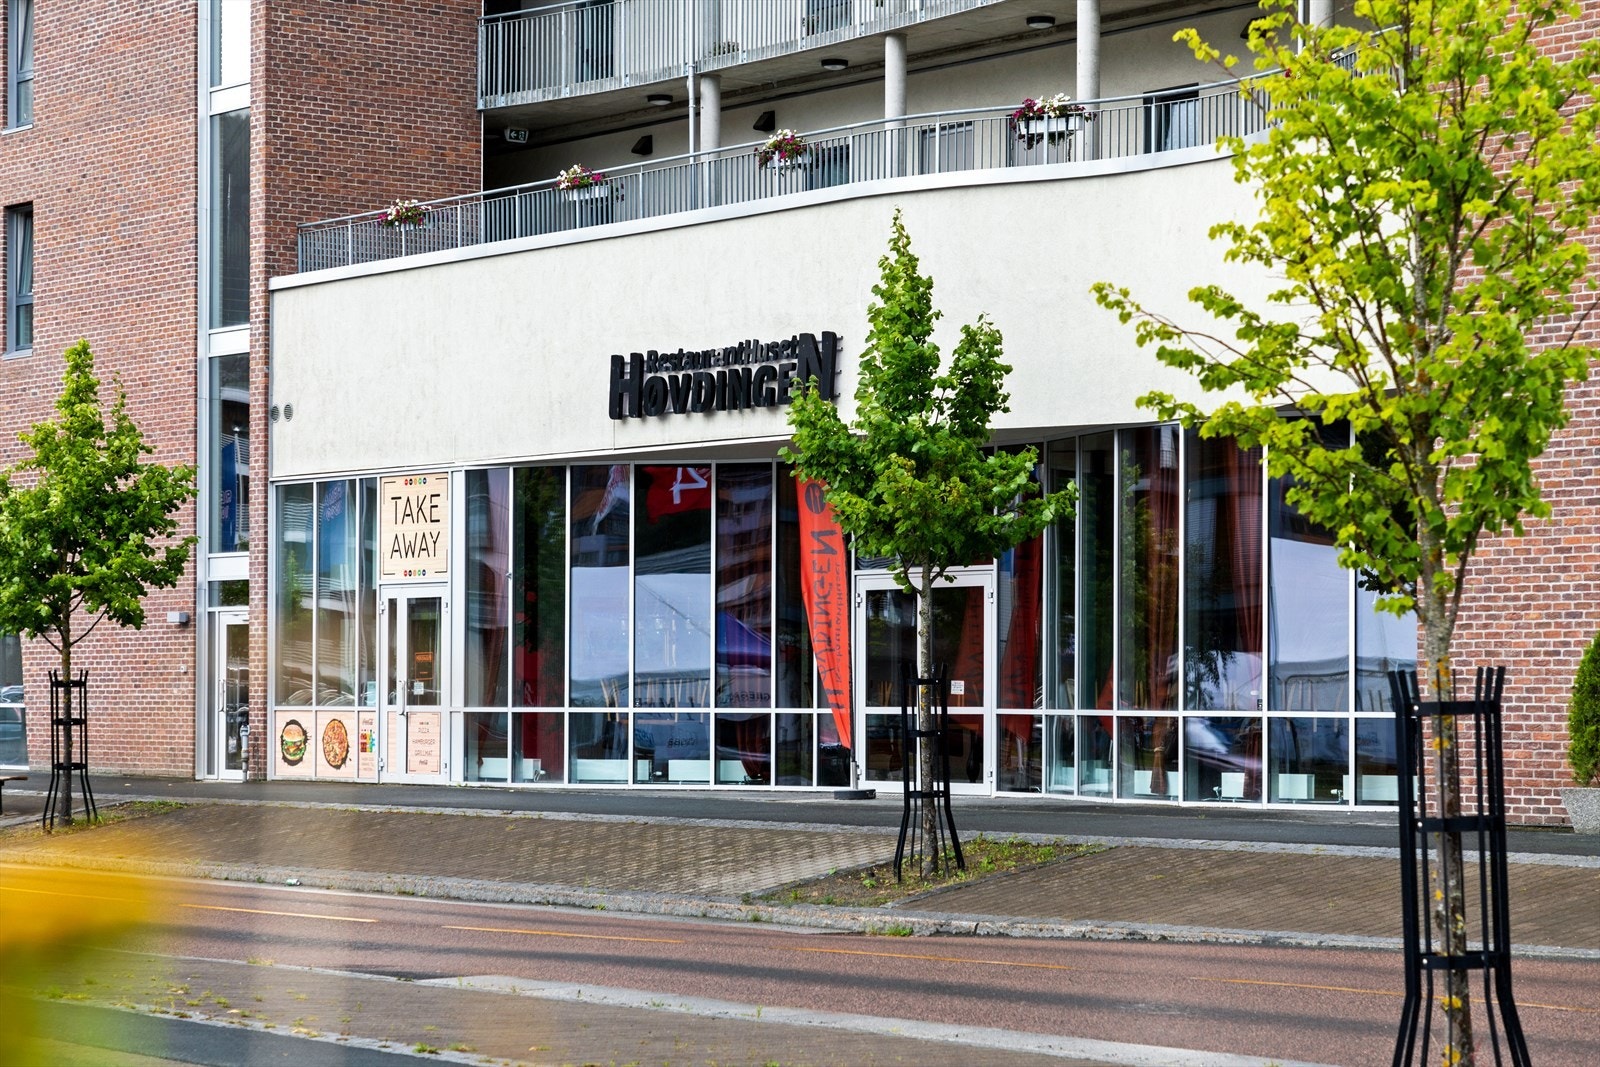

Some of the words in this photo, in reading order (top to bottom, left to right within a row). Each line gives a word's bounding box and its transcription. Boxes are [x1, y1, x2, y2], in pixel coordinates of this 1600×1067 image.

[646, 335, 800, 374] RestaurantHuset
[391, 494, 441, 525] TAKE
[390, 531, 441, 559] AWAY
